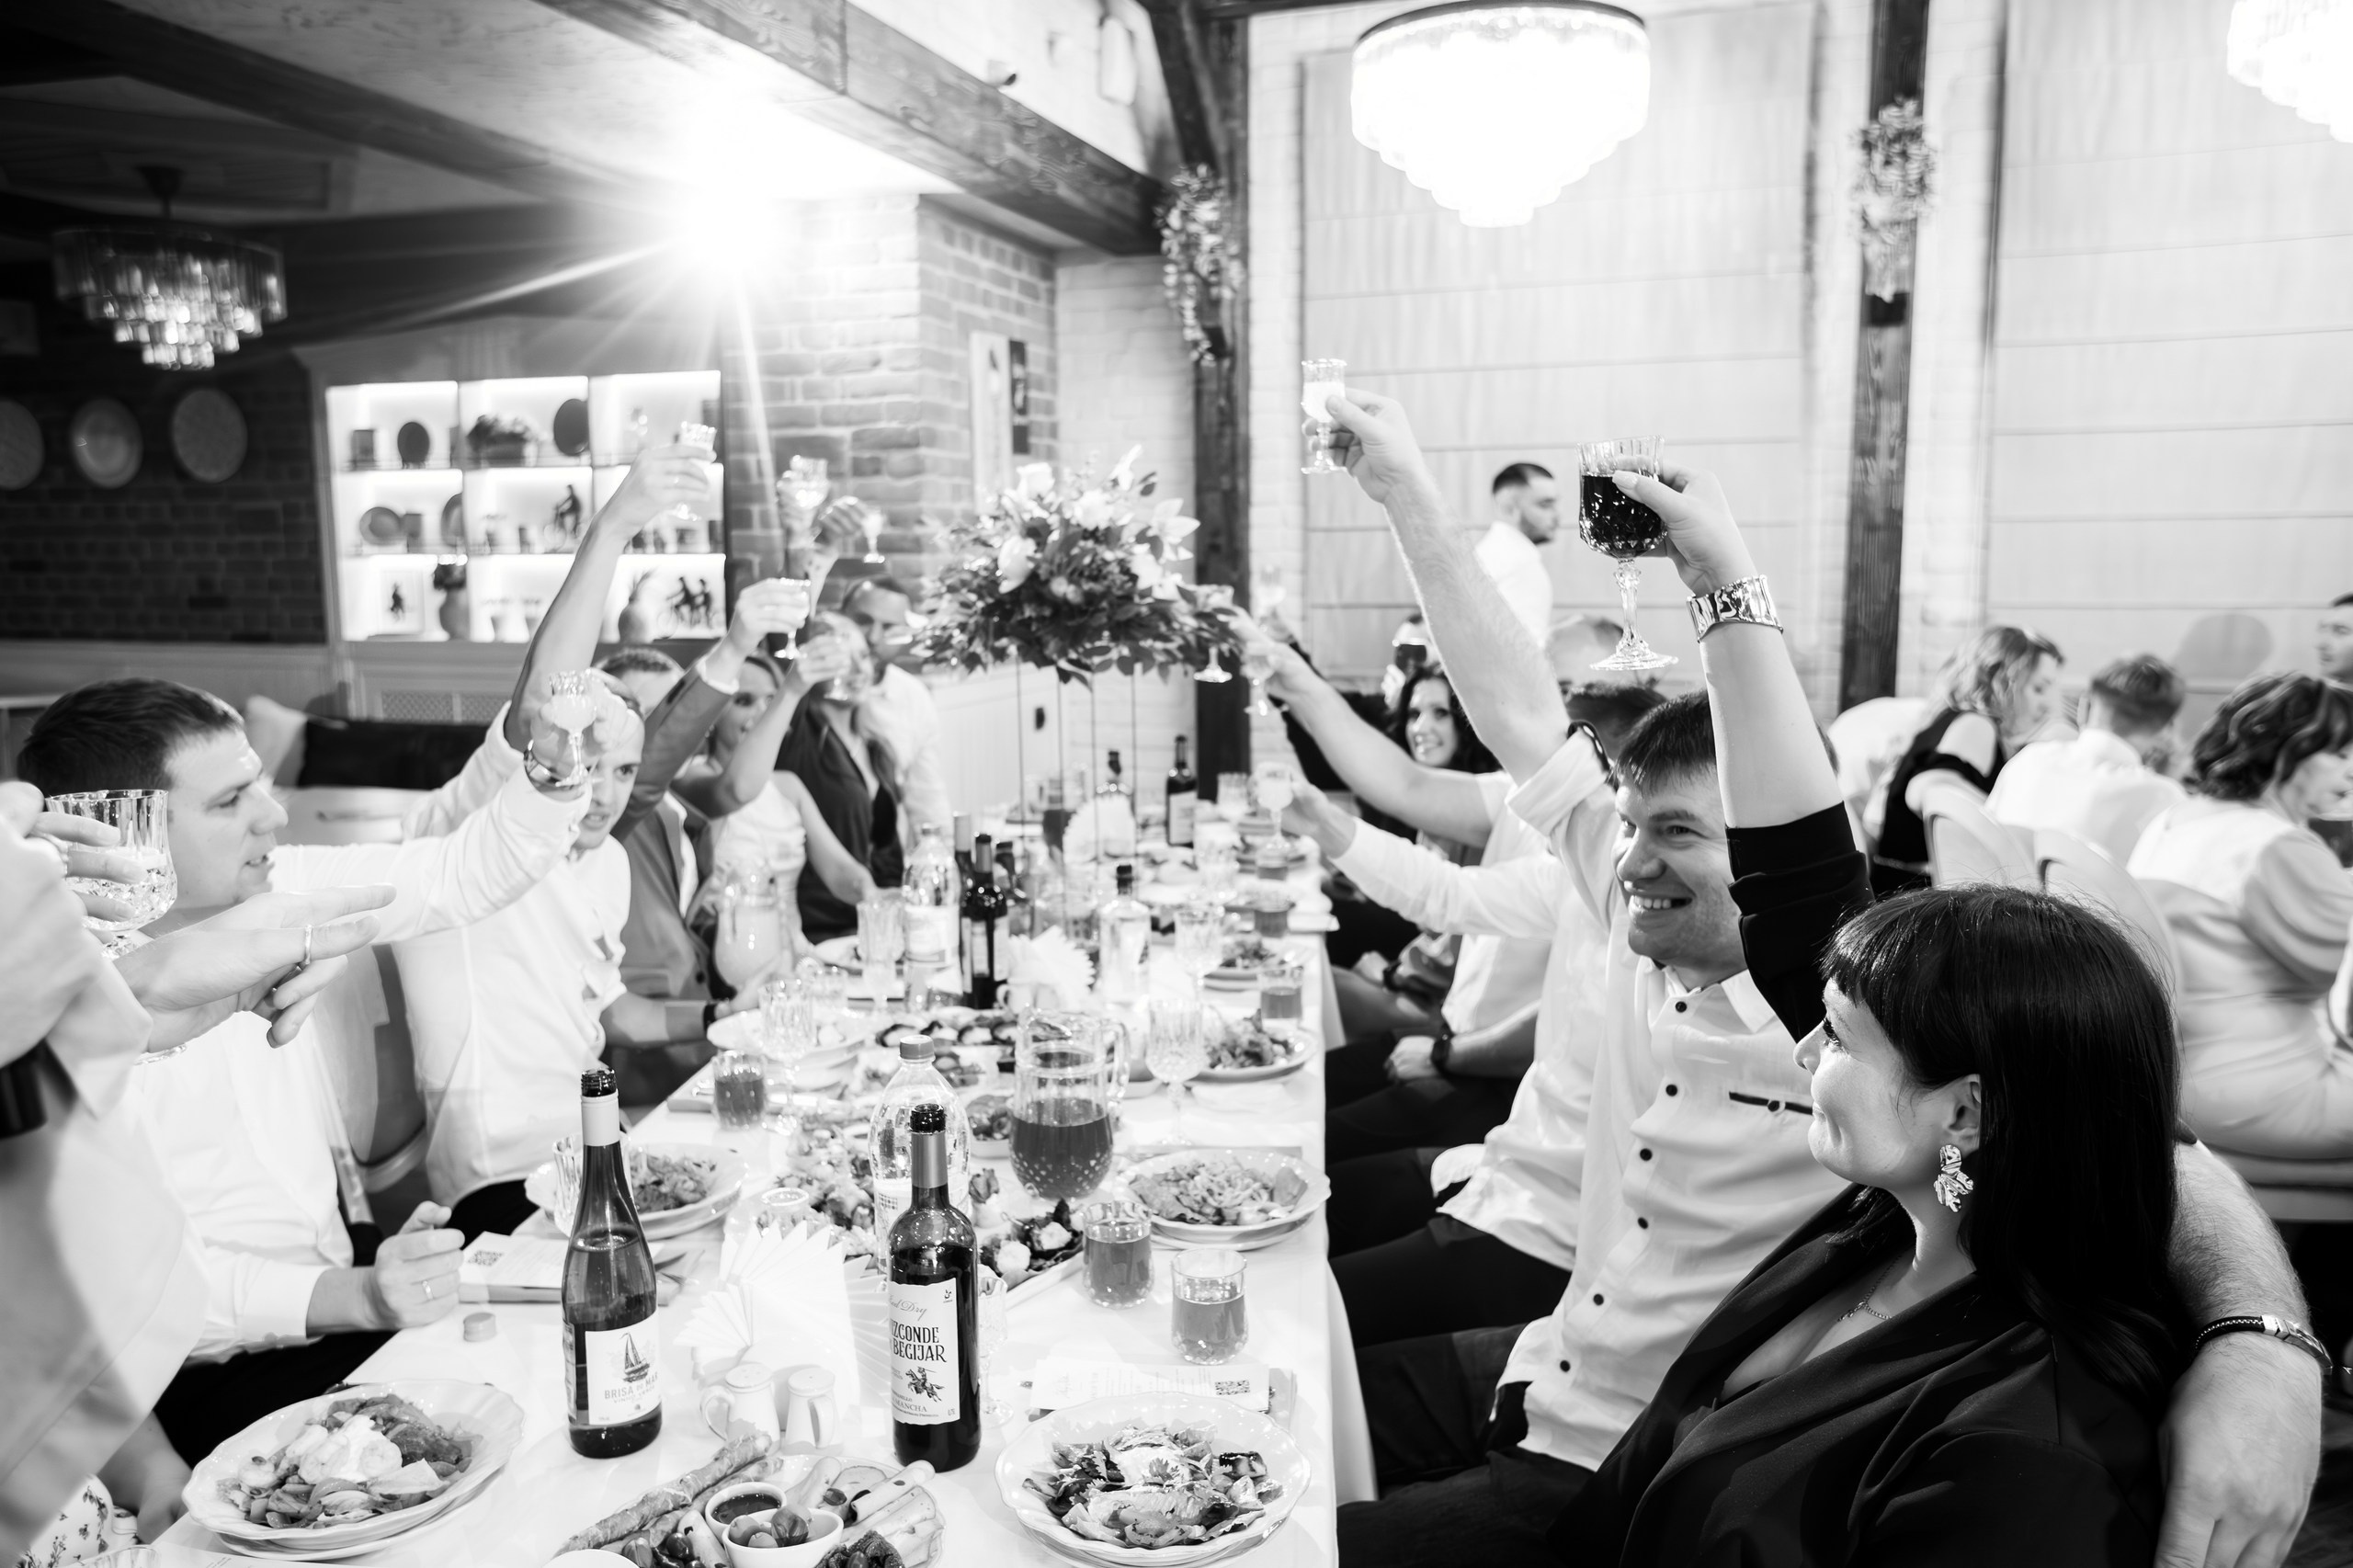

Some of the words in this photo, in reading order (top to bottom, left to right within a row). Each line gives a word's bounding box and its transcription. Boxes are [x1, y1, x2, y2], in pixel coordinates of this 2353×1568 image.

[900, 1301, 927, 1322] Dry
[893, 1337, 947, 1362] BEGIJAR
[604, 1385, 634, 1399] BRISA
